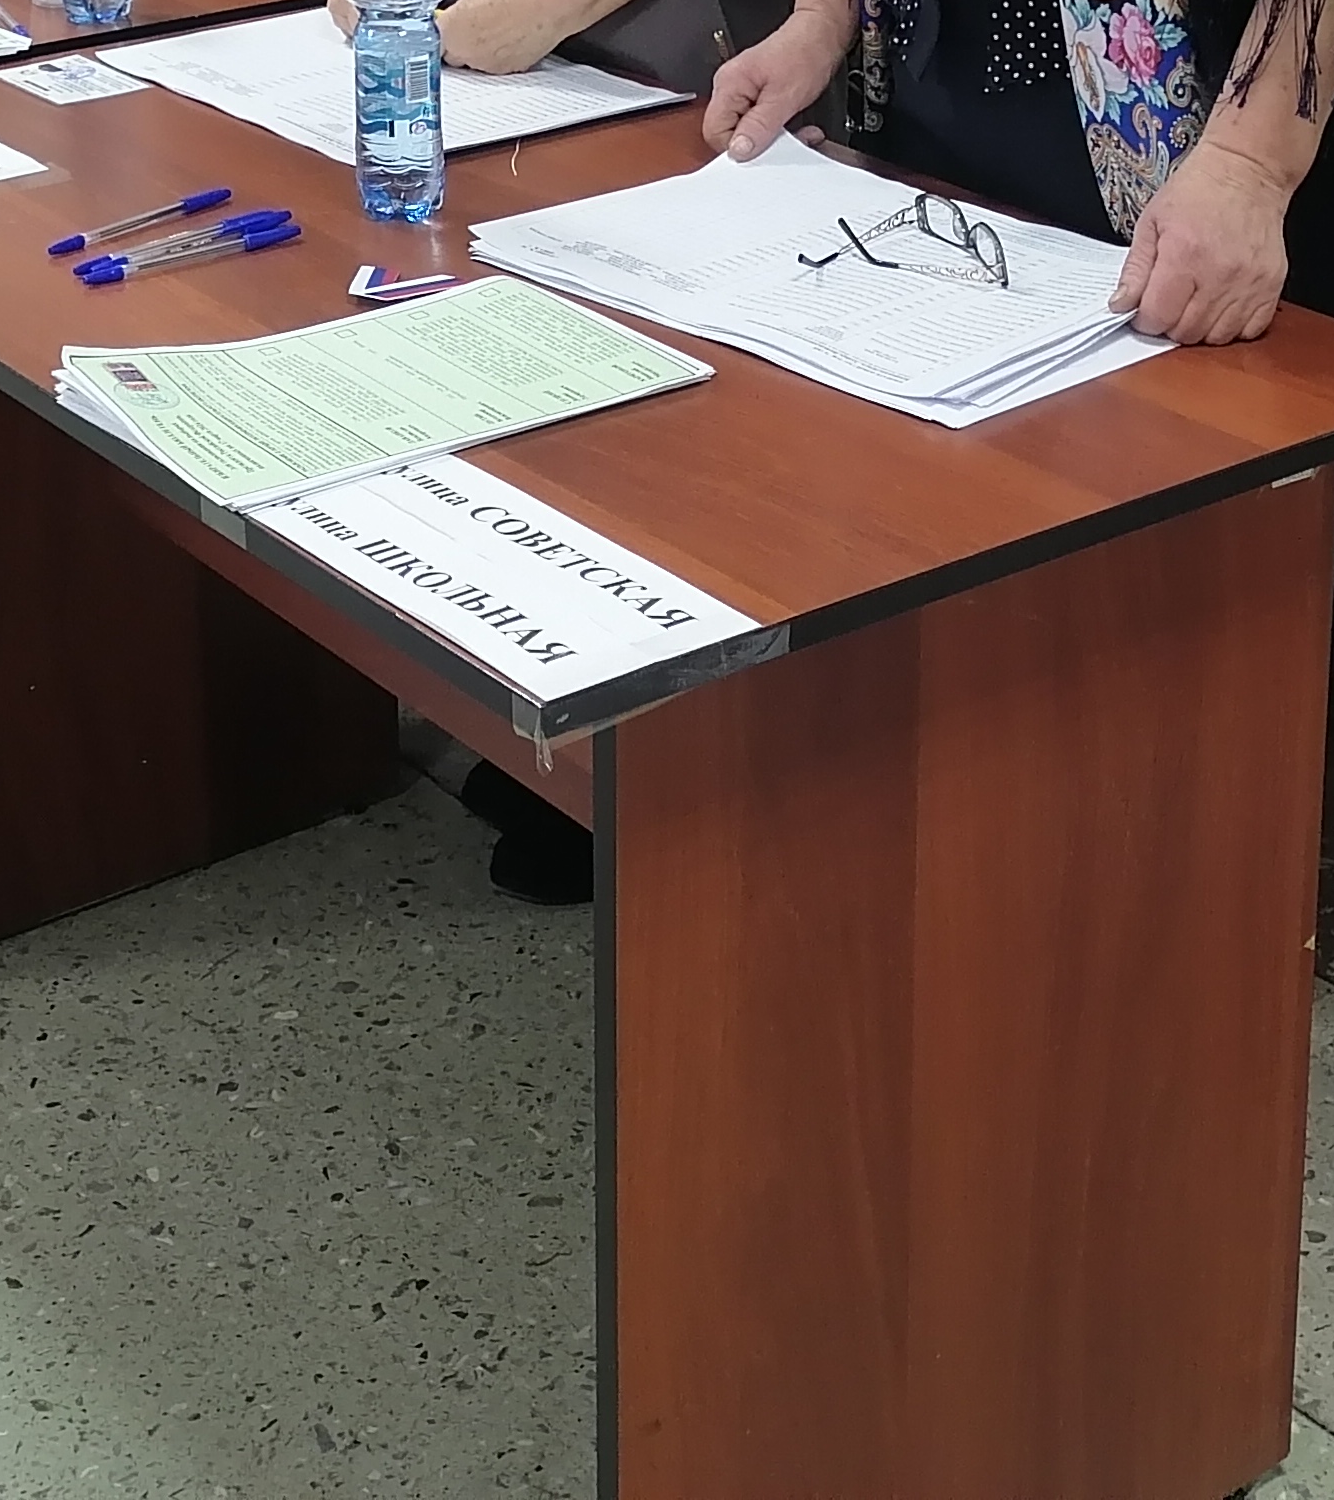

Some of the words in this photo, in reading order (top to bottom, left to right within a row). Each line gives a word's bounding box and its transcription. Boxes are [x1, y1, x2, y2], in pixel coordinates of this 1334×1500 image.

[270, 497, 359, 541] улица
[353, 538, 580, 665] ШКОЛЬНАЯ
[380, 465, 470, 507] улица
[469, 506, 701, 632] СОВЕТСКАЯ
